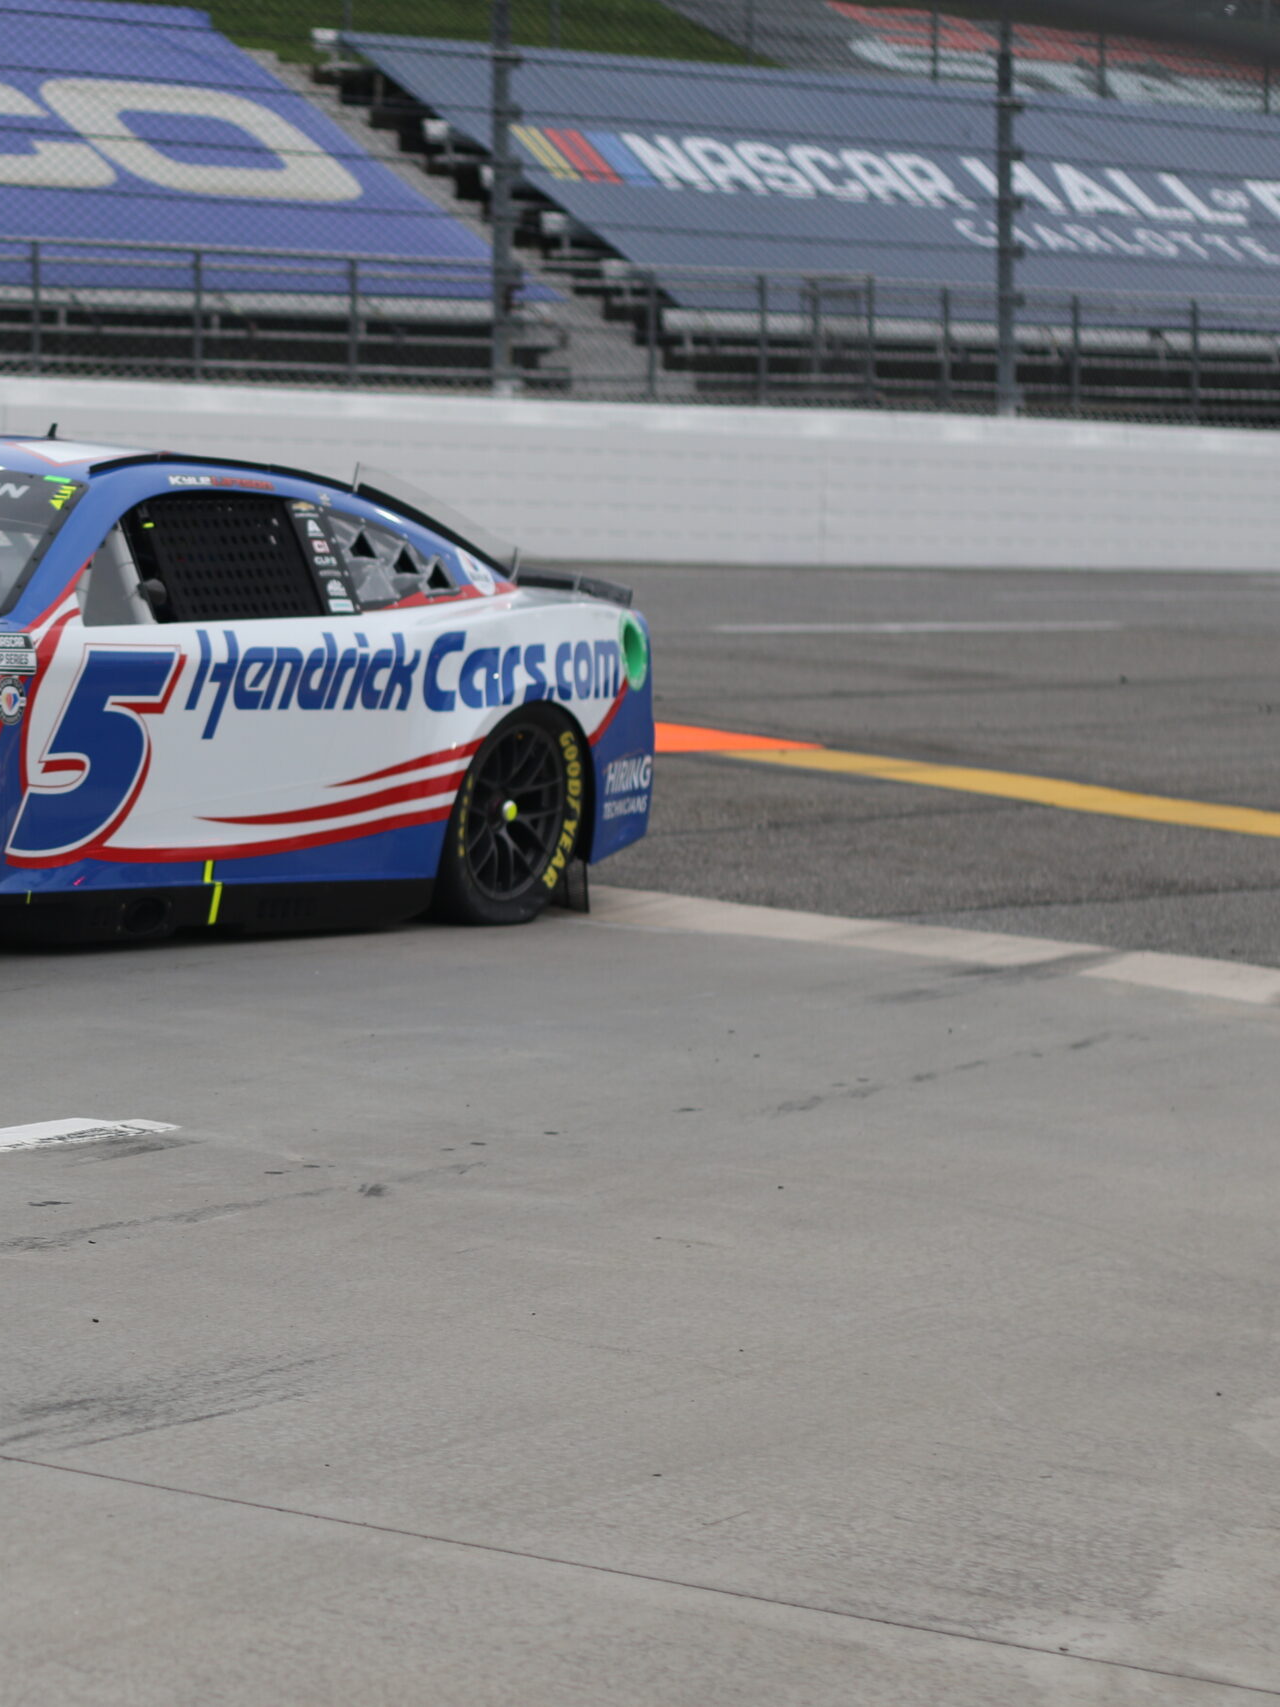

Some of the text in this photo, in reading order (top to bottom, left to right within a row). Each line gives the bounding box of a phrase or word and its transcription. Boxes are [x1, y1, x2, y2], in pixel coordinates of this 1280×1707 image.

[622, 132, 978, 210] NASCAR
[960, 155, 1248, 226] HALL
[5, 653, 29, 665] SERIES
[6, 644, 184, 866] 5
[605, 755, 652, 795] HIRING
[542, 731, 582, 889] GOODYEAR
